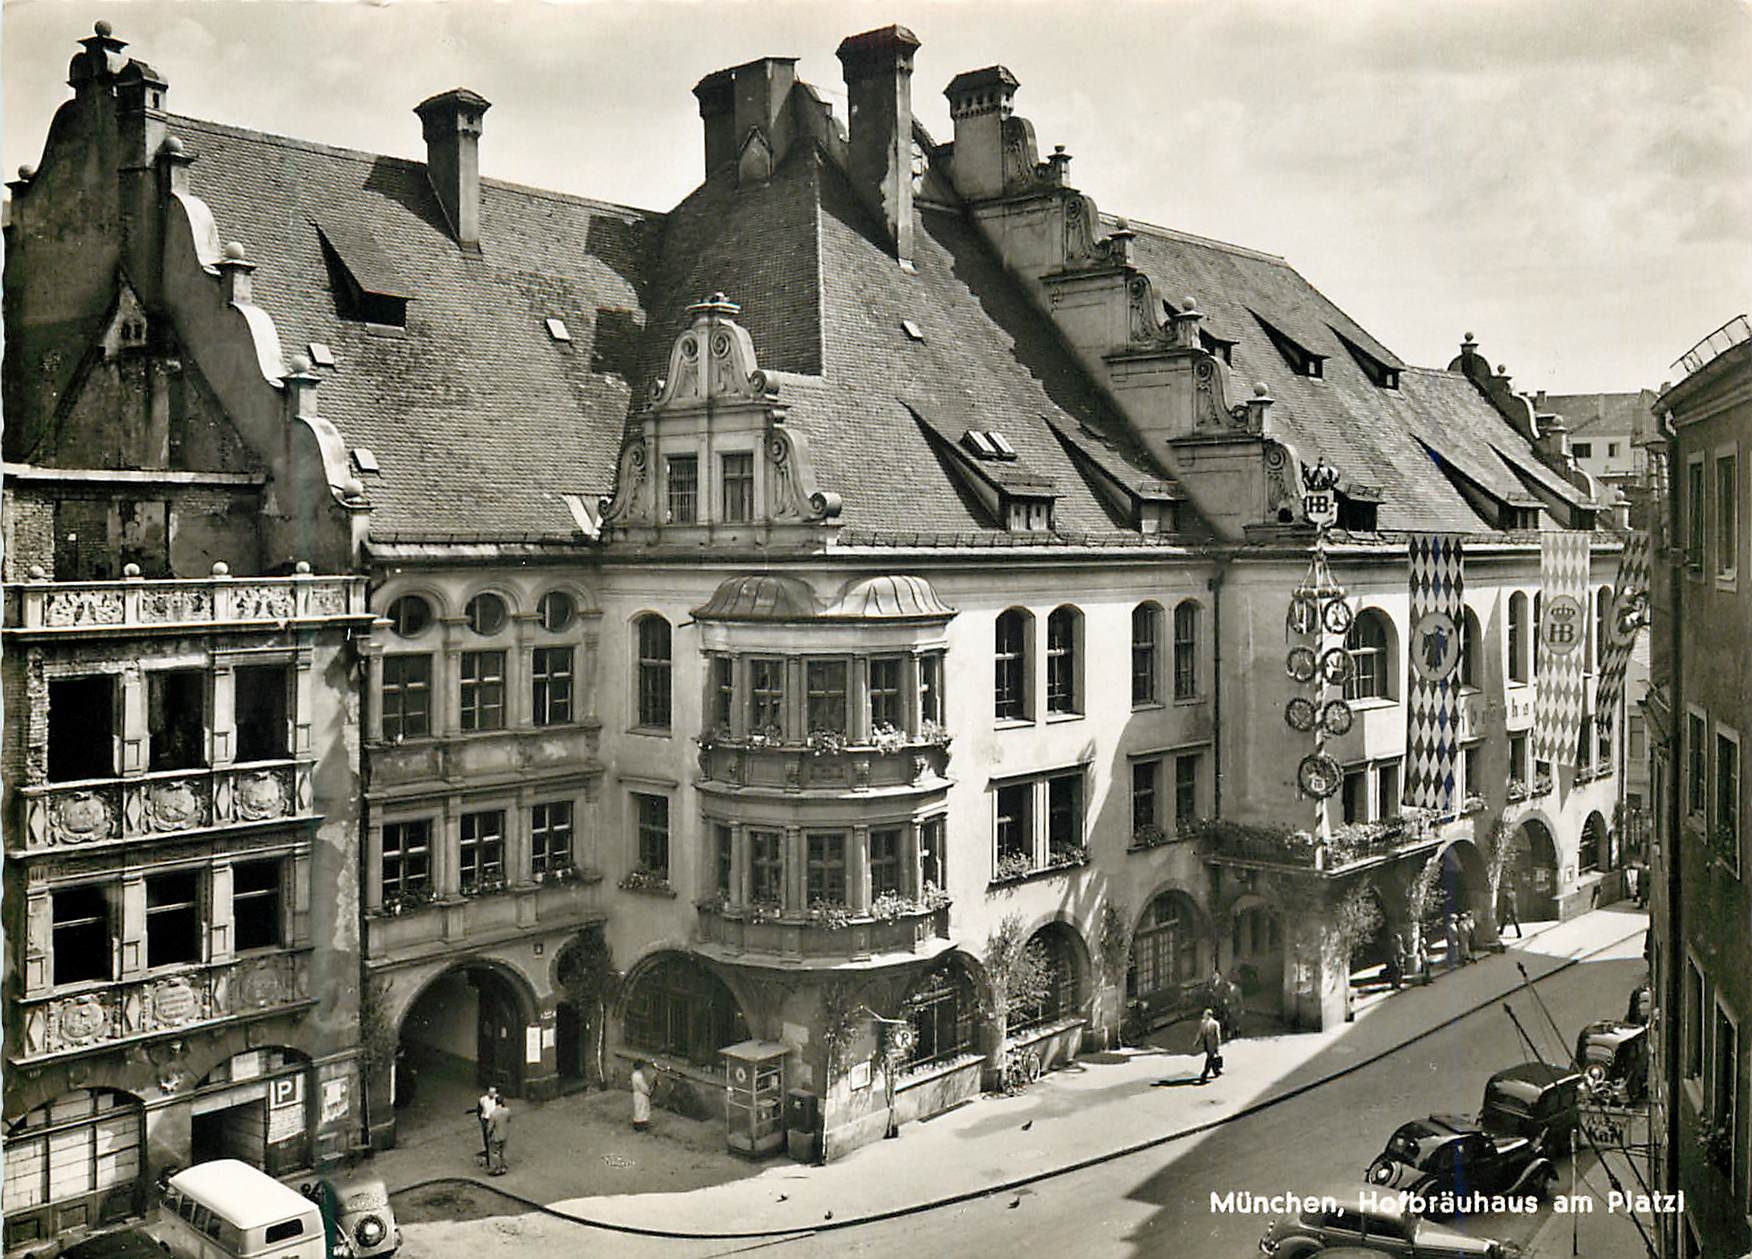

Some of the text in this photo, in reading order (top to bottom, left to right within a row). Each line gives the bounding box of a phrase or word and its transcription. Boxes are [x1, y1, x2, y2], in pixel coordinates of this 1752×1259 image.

[1308, 496, 1329, 513] HB
[1549, 623, 1574, 643] HB
[277, 1080, 293, 1103] P
